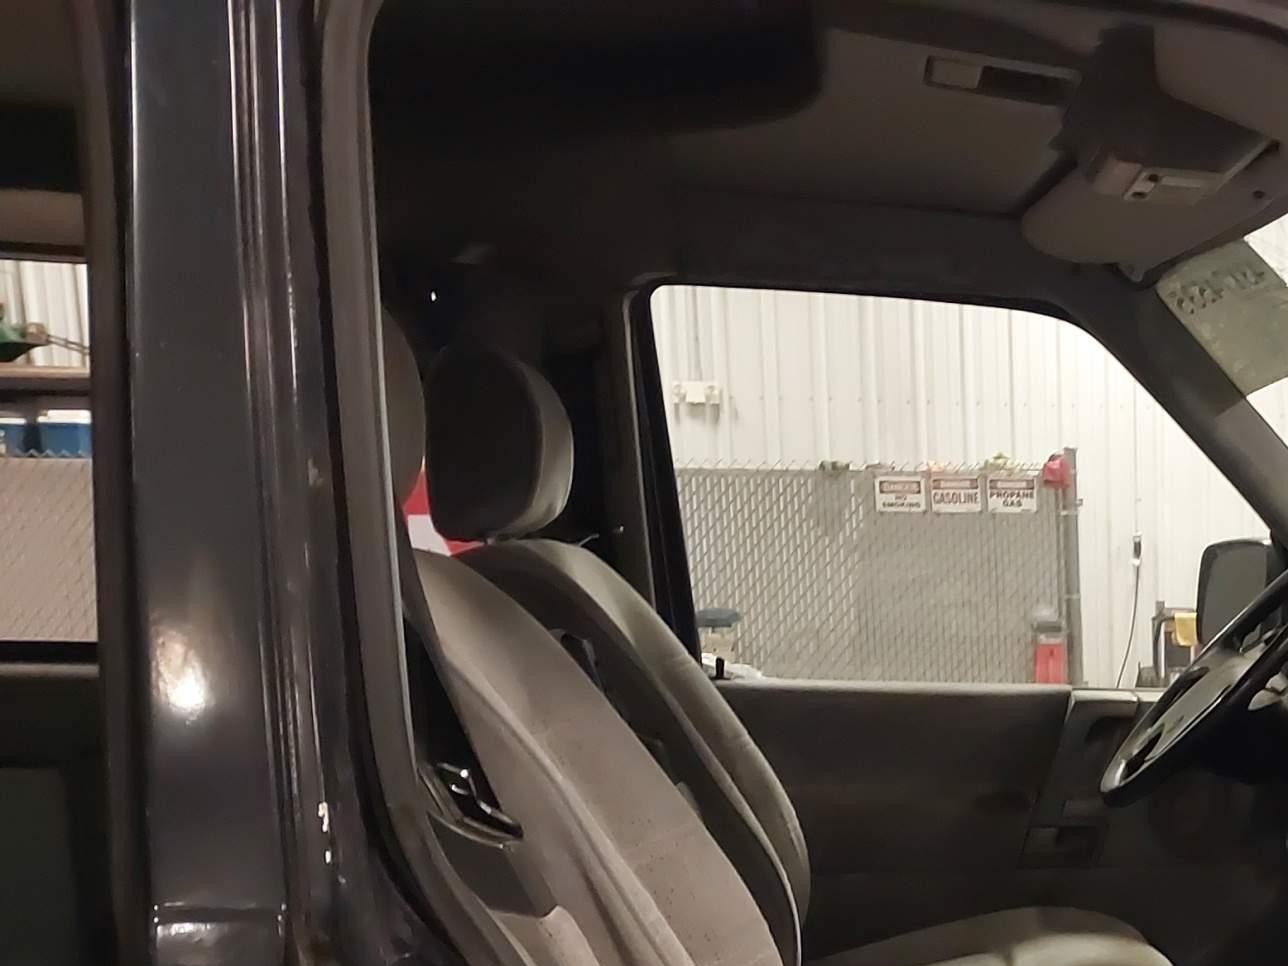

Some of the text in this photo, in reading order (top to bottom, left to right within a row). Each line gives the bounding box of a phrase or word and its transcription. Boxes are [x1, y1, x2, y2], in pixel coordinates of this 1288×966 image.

[933, 491, 979, 504] GASOLINE
[989, 490, 1034, 499] PROPANE
[1002, 499, 1023, 507] GAS
